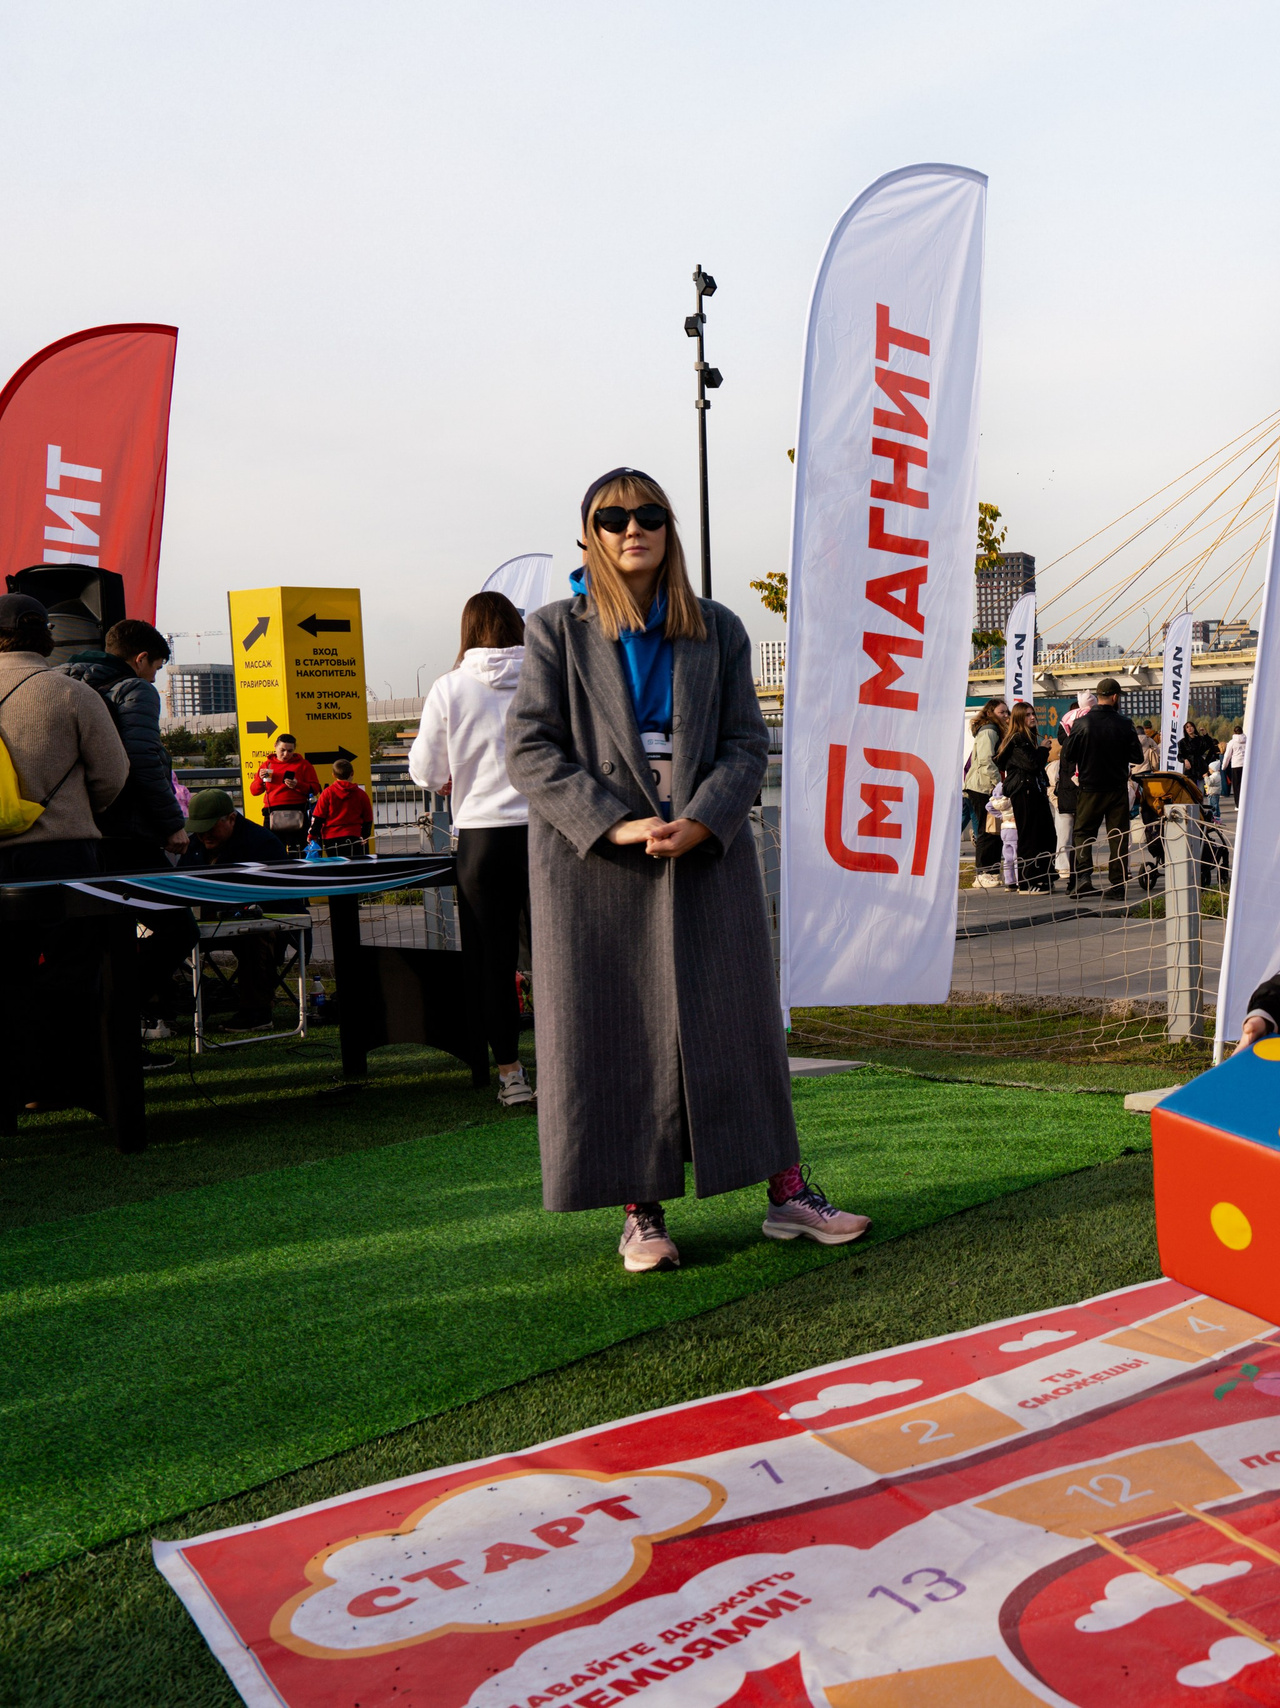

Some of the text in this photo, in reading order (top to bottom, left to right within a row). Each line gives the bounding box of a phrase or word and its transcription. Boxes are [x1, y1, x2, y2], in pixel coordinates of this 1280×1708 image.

[858, 302, 930, 712] МАГНИТ
[312, 648, 338, 657] ВХОД
[244, 660, 272, 669] МАССАЖ
[303, 657, 356, 667] СТАРТОВЫЙ
[296, 670, 357, 678] НАКОПИТЕЛЬ
[240, 679, 279, 689] ГРАВИРОВКА
[317, 691, 360, 699] ЭТНОРАН,
[316, 702, 341, 711] 3 КМ,
[306, 712, 352, 721] TIMERKIDS
[245, 761, 254, 769] ПО
[1185, 1315, 1226, 1334] 4
[1017, 1358, 1150, 1411] СМОЖЕШЬ!
[1040, 1367, 1083, 1385] ТЫ
[900, 1419, 954, 1446] 2
[1064, 1473, 1156, 1509] 12
[345, 1495, 642, 1619] СТАРТ
[866, 1566, 967, 1615] 13
[508, 1571, 796, 1708] АВАЙТЕ ДРУЖИТЬ
[558, 1589, 813, 1708] ЕМЬЯМИ!
